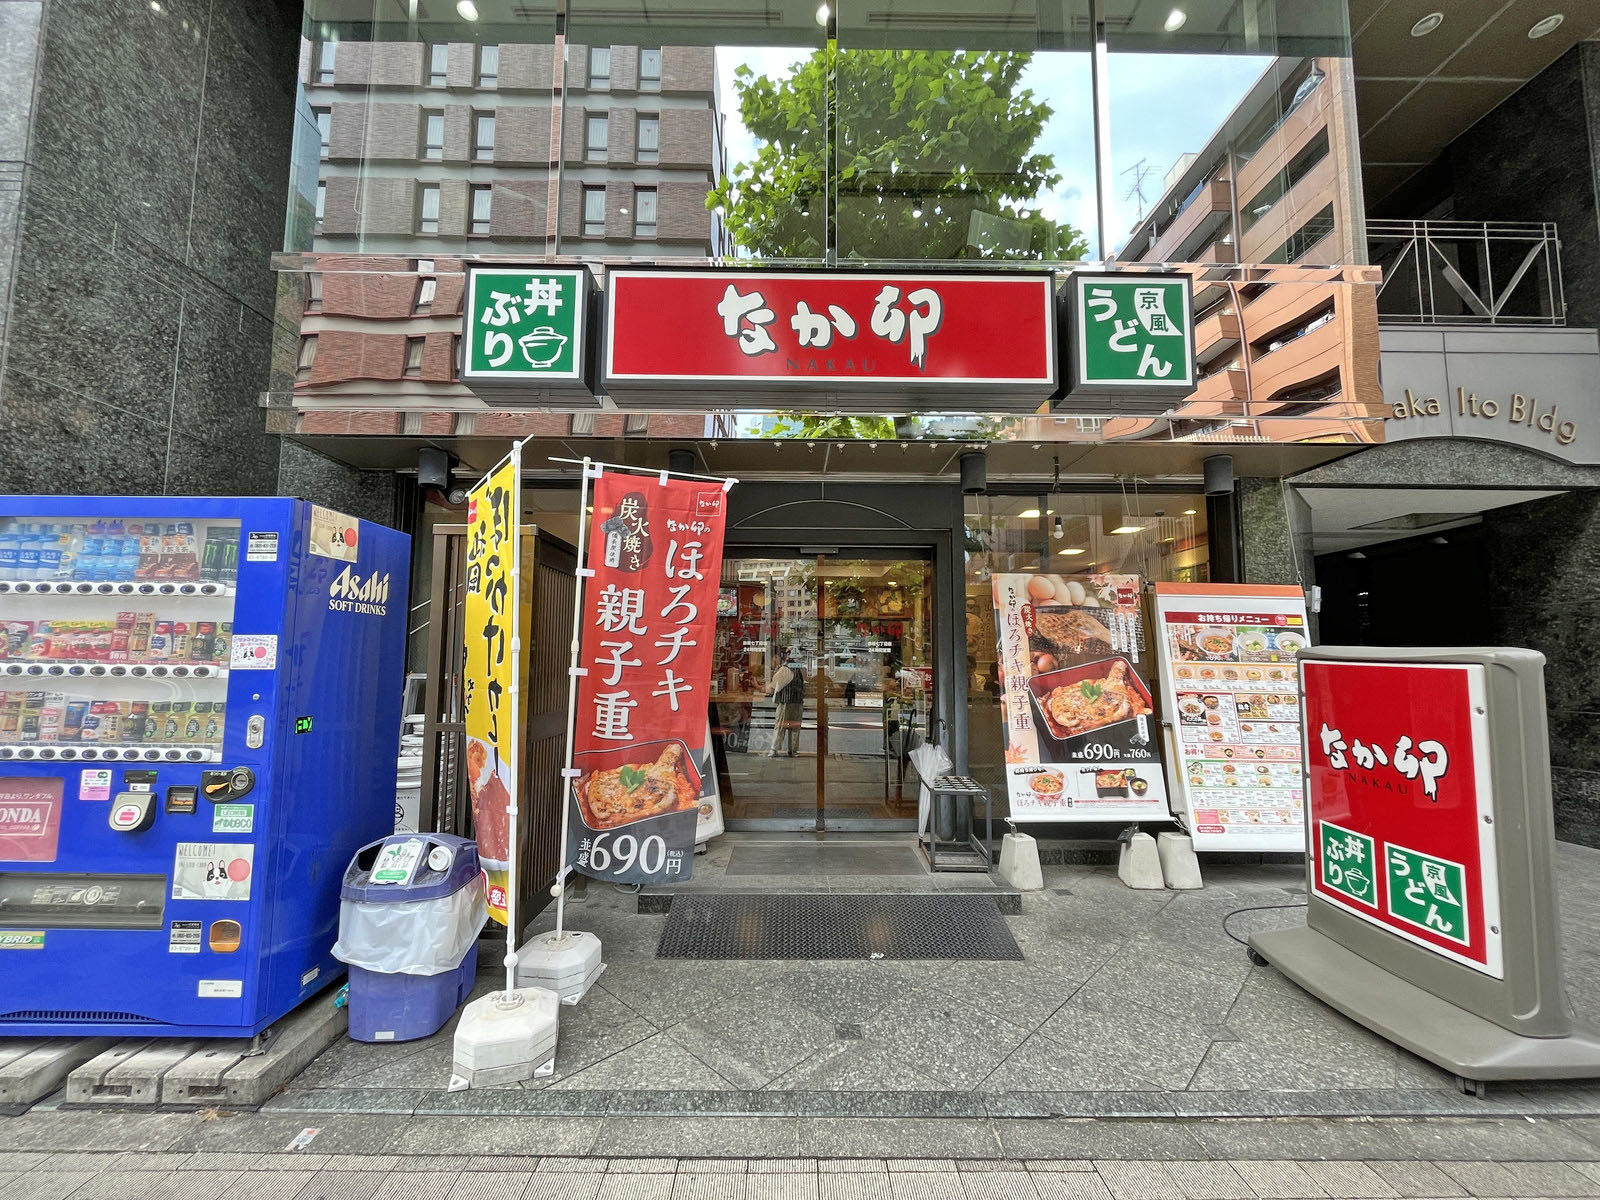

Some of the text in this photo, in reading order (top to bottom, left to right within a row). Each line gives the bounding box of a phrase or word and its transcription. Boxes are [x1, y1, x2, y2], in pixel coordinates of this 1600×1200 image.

[717, 284, 942, 371] なか卯
[1139, 291, 1169, 333] 京風
[1088, 288, 1173, 378] うどん
[786, 358, 876, 371] NAKAU
[1457, 387, 1500, 418] Ito
[1509, 393, 1577, 445] Bldg
[699, 500, 720, 508] なか卯
[619, 498, 650, 571] 炭火焼き
[666, 518, 711, 536] なか卯の
[329, 564, 390, 604] Asahi
[328, 598, 386, 616] SOFT DRINKS
[651, 539, 706, 713] ほろチキ
[1198, 614, 1270, 624] お持ち帰りメニュー
[591, 583, 649, 741] 親子重
[1007, 613, 1031, 731] ほろチキ親子重
[1320, 723, 1449, 802] なか卯
[1349, 773, 1408, 794] NAKAU
[178, 844, 216, 857] WELCOME!
[576, 837, 592, 868] 並盛
[1390, 852, 1453, 933] うどん
[1426, 865, 1450, 900] 京風
